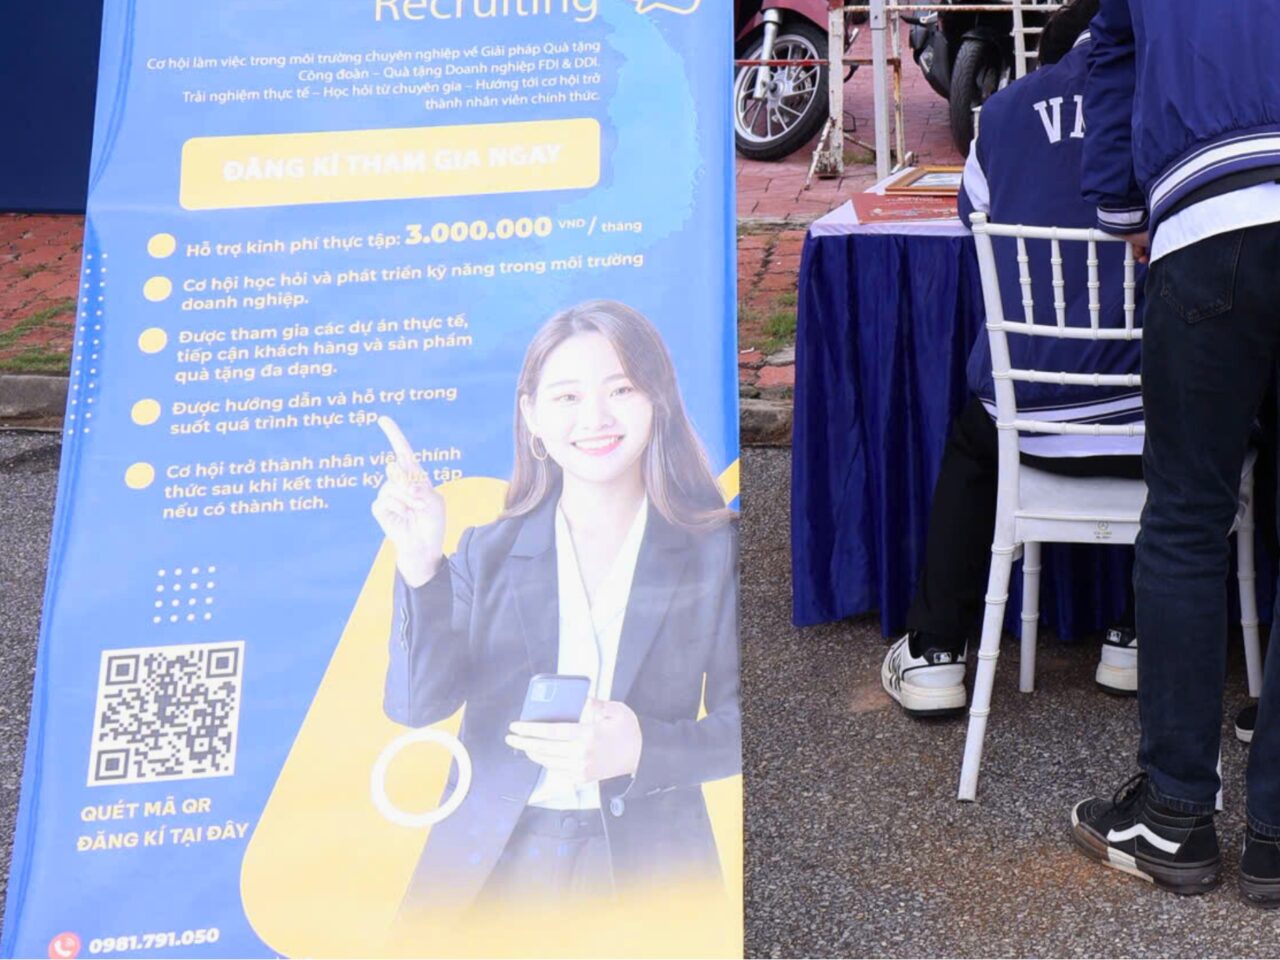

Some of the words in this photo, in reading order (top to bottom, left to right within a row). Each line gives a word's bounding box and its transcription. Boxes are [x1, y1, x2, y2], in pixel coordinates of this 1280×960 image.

[146, 57, 167, 71] Cơ
[168, 56, 190, 71] hội
[193, 56, 218, 69] làm
[221, 55, 248, 69] việc
[250, 55, 286, 69] trong
[289, 52, 315, 65] môi
[317, 51, 363, 66] trường
[365, 49, 412, 64] chuyên
[415, 46, 461, 63] nghiệp
[464, 45, 479, 58] về
[481, 44, 505, 58] Giải
[508, 43, 541, 58] pháp
[543, 42, 570, 56] Quà
[572, 40, 601, 55] tặng
[343, 149, 427, 176] THAM
[433, 147, 483, 172] GIA
[488, 142, 563, 168] NGAY
[186, 240, 212, 257] Hỗ
[216, 242, 243, 259] trợ
[246, 238, 285, 254] kinh
[289, 235, 319, 254] phí
[323, 234, 364, 251] thực
[368, 232, 401, 249] tập:
[405, 216, 553, 245] 3.000.000
[558, 217, 587, 229] VND
[587, 216, 598, 236] /
[601, 219, 643, 233] tháng
[183, 278, 208, 292] Cơ
[211, 276, 239, 293] hội
[243, 275, 276, 292] học
[280, 272, 307, 288] hỏi
[312, 272, 333, 285] và
[336, 268, 377, 286] phát
[381, 264, 422, 282] triển
[426, 263, 448, 281] kỹ
[451, 262, 495, 278] năng
[499, 260, 546, 275] trong
[550, 256, 583, 271] môi
[587, 253, 644, 269] trường
[181, 295, 238, 311] doanh
[242, 292, 310, 310] nghiệp.
[178, 329, 226, 346] Được
[230, 326, 277, 341] tham
[282, 325, 310, 341] gia
[313, 322, 344, 337] các
[348, 320, 374, 337] dự
[377, 319, 399, 333] án
[403, 316, 442, 333] thực
[447, 313, 469, 329] tế,
[171, 400, 221, 417] Được
[225, 396, 284, 414] hướng
[288, 392, 322, 409] dẫn
[327, 393, 347, 407] và
[352, 388, 375, 405] hỗ
[380, 389, 406, 406] trợ
[409, 387, 458, 402] trong
[170, 418, 211, 435] suốt
[215, 418, 250, 435] quá
[254, 413, 298, 430] trình
[302, 411, 344, 429] thực
[80, 802, 139, 823] QUÉT
[143, 795, 177, 818] MÃ
[182, 797, 212, 814] QR
[76, 830, 139, 852] ĐĂNG
[143, 824, 166, 847] KÍ
[170, 826, 203, 848] TẠI
[206, 820, 249, 841] ĐÂY
[88, 927, 220, 955] 0981.791.050
